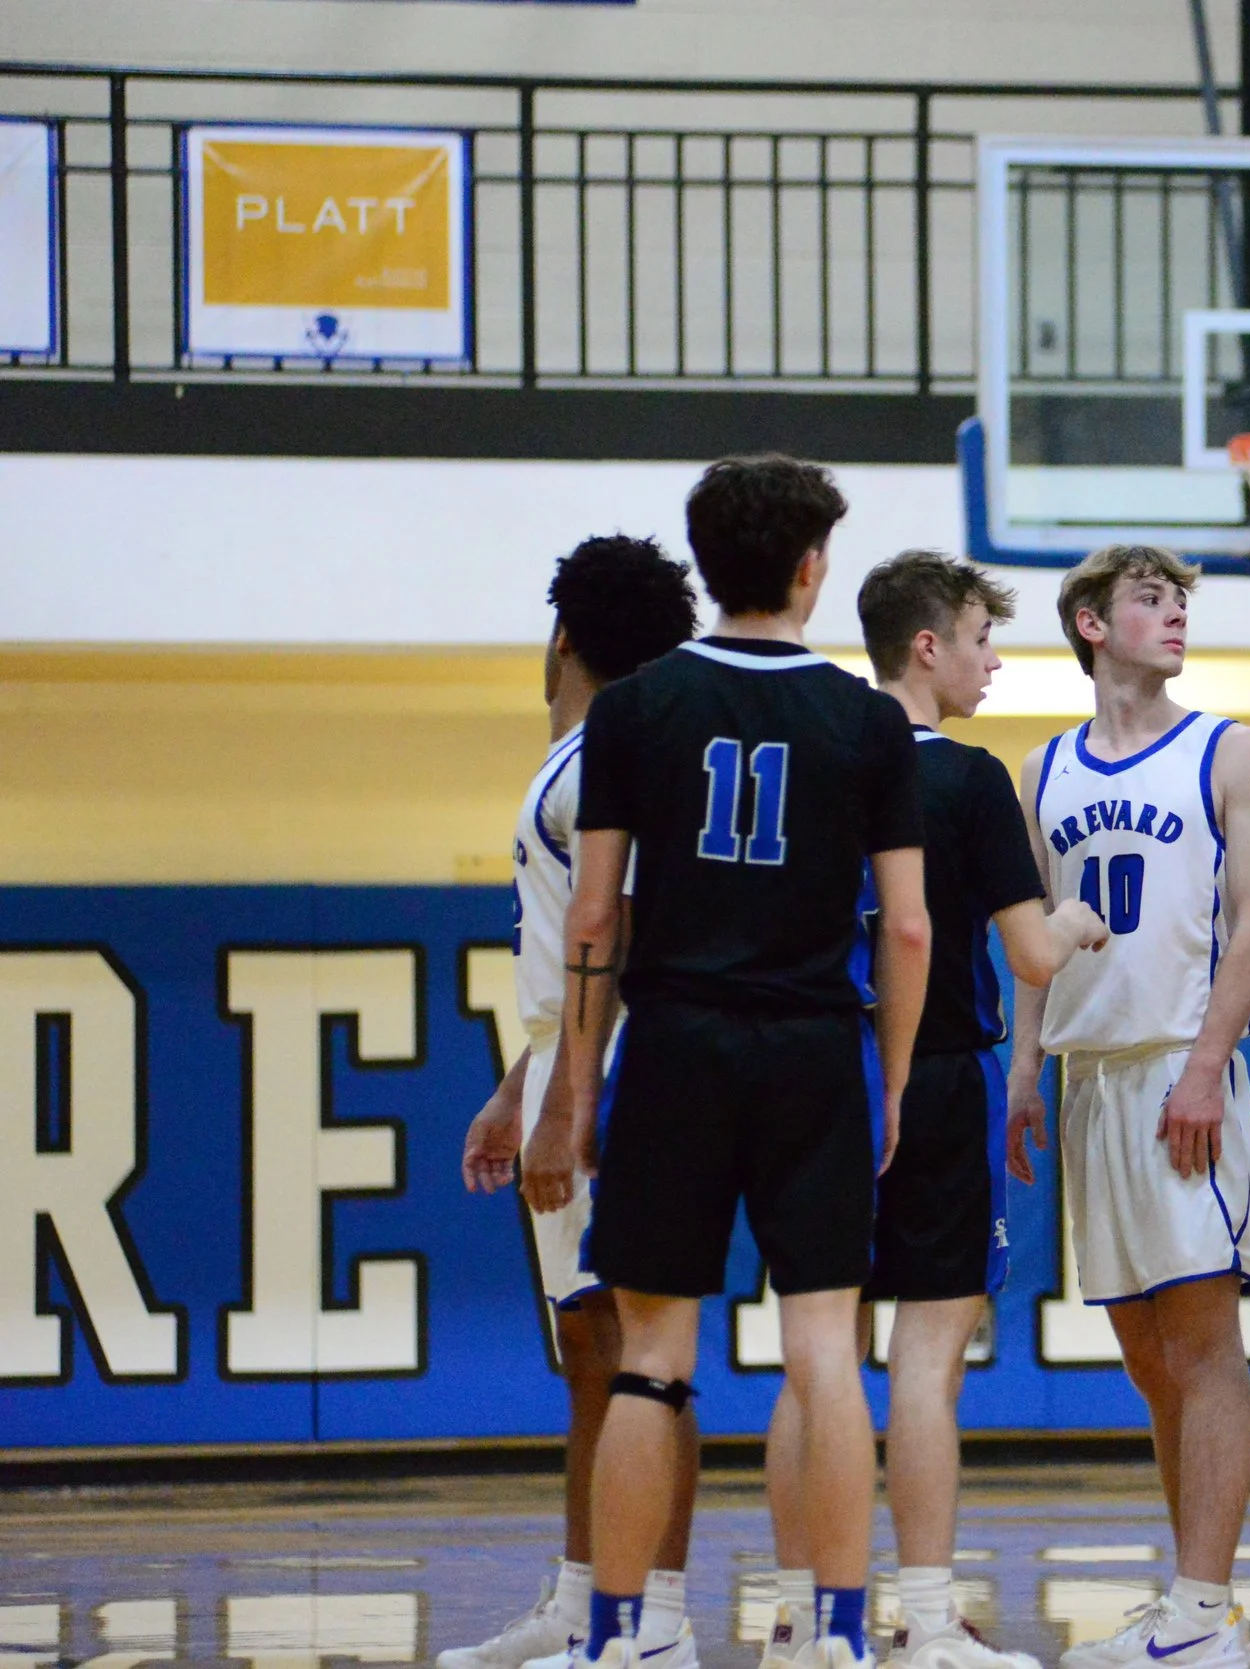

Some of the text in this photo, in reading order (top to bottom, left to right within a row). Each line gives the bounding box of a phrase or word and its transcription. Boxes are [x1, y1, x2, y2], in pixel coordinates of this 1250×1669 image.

[235, 194, 416, 235] PLATT
[697, 737, 789, 866] 11
[1049, 799, 1184, 857] BREVARD
[1079, 853, 1145, 936] 10
